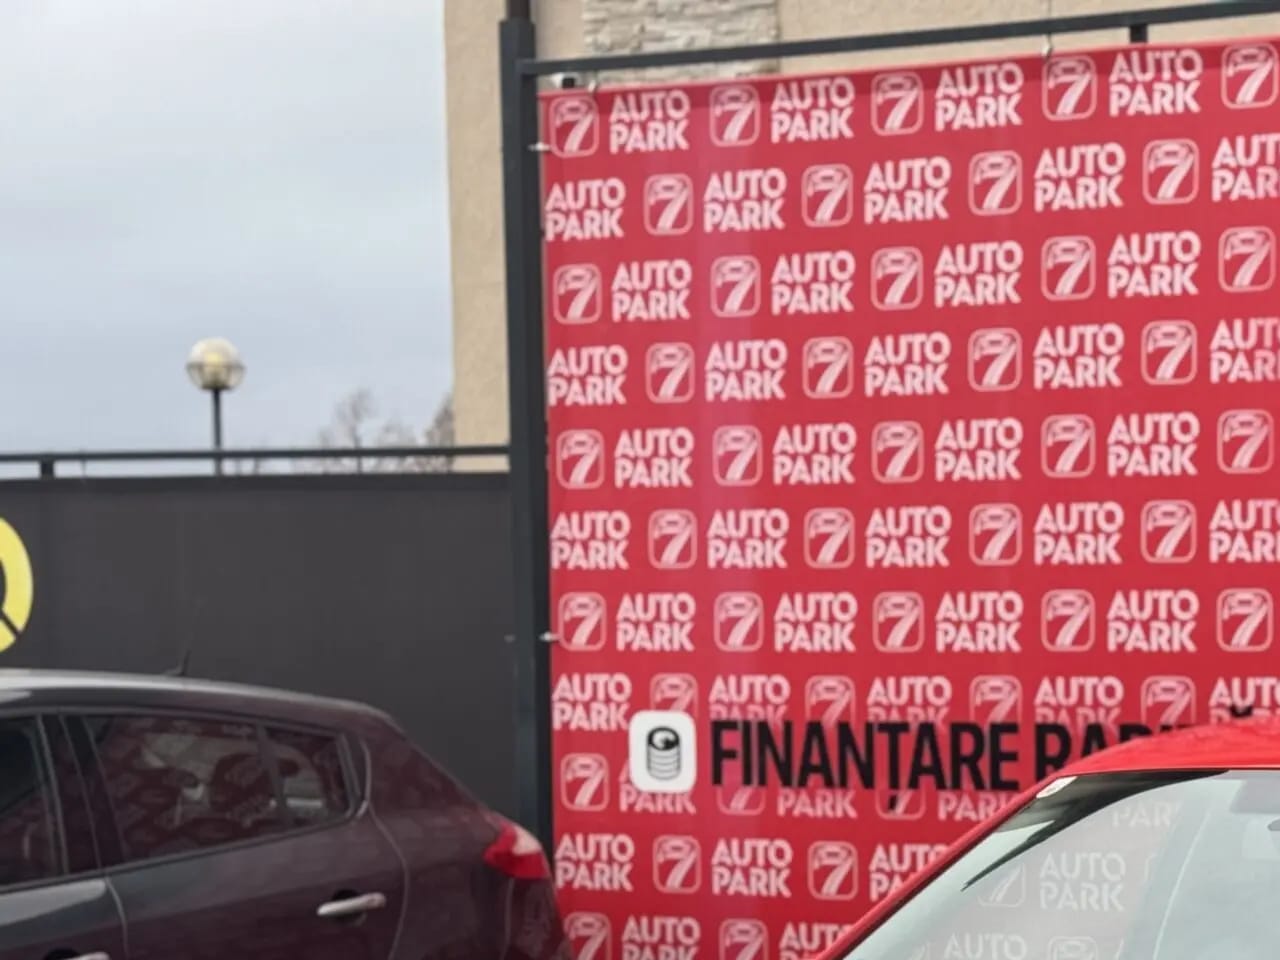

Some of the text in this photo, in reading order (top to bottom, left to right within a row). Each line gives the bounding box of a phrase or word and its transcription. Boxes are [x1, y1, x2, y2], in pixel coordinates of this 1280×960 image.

[936, 62, 1023, 100] AUTO
[1109, 49, 1201, 86] AUTO
[610, 89, 691, 123] AUTO
[771, 77, 855, 114] AUTO
[1110, 79, 1200, 116] PARK
[771, 106, 853, 143] PARK
[936, 93, 1021, 131] PARK
[610, 119, 688, 153] PARK
[864, 157, 951, 192] AUTO
[1035, 143, 1125, 179] AUTO
[544, 178, 625, 211] AUTO
[704, 168, 786, 202] AUTO
[1035, 175, 1122, 211] PARK
[704, 198, 784, 232] PARK
[865, 188, 948, 223] PARK
[543, 207, 623, 242] PARK
[935, 241, 1023, 277] AUTO
[1108, 231, 1201, 266] AUTO
[612, 259, 692, 292] AUTO
[771, 251, 855, 285] AUTO
[1108, 262, 1197, 298] PARK
[612, 288, 689, 321] PARK
[772, 281, 853, 315] PARK
[935, 272, 1020, 307] PARK
[705, 339, 787, 371] AUTO
[865, 332, 951, 366] AUTO
[1034, 323, 1124, 357] AUTO
[547, 345, 628, 377] AUTO
[1034, 354, 1121, 389] PARK
[547, 374, 626, 406] PARK
[706, 368, 785, 401] PARK
[865, 362, 948, 396] PARK
[615, 427, 694, 457] AUTO
[773, 423, 856, 455] AUTO
[935, 418, 1023, 450] AUTO
[1108, 412, 1199, 445] AUTO
[615, 457, 692, 487] PARK
[774, 452, 854, 484] PARK
[936, 448, 1020, 481] PARK
[1108, 443, 1197, 476] PARK
[550, 511, 630, 541] AUTO
[707, 508, 789, 539] AUTO
[866, 506, 951, 537] AUTO
[1034, 501, 1124, 534] AUTO
[551, 539, 628, 569] PARK
[708, 537, 787, 568] PARK
[866, 537, 949, 567] PARK
[1035, 532, 1121, 564] PARK
[617, 593, 696, 623] AUTO
[774, 592, 857, 623] AUTO
[936, 591, 1023, 621] AUTO
[1107, 590, 1199, 620] AUTO
[617, 621, 694, 651] PARK
[775, 621, 855, 652] PARK
[936, 621, 1020, 652] PARK
[1108, 620, 1196, 652] PARK
[553, 673, 631, 702] AUTO
[710, 674, 790, 702] AUTO
[867, 676, 952, 704] AUTO
[1034, 676, 1124, 706] AUTO
[553, 702, 630, 731] PARK
[777, 789, 858, 819] PARK
[554, 834, 634, 863] AUTO
[712, 839, 793, 867] AUTO
[555, 860, 632, 891] PARK
[712, 865, 791, 897] PARK
[1039, 852, 1126, 881] AUTO
[1039, 880, 1125, 911] PARK
[622, 916, 700, 945] AUTO
[943, 934, 1028, 960] AUTO
